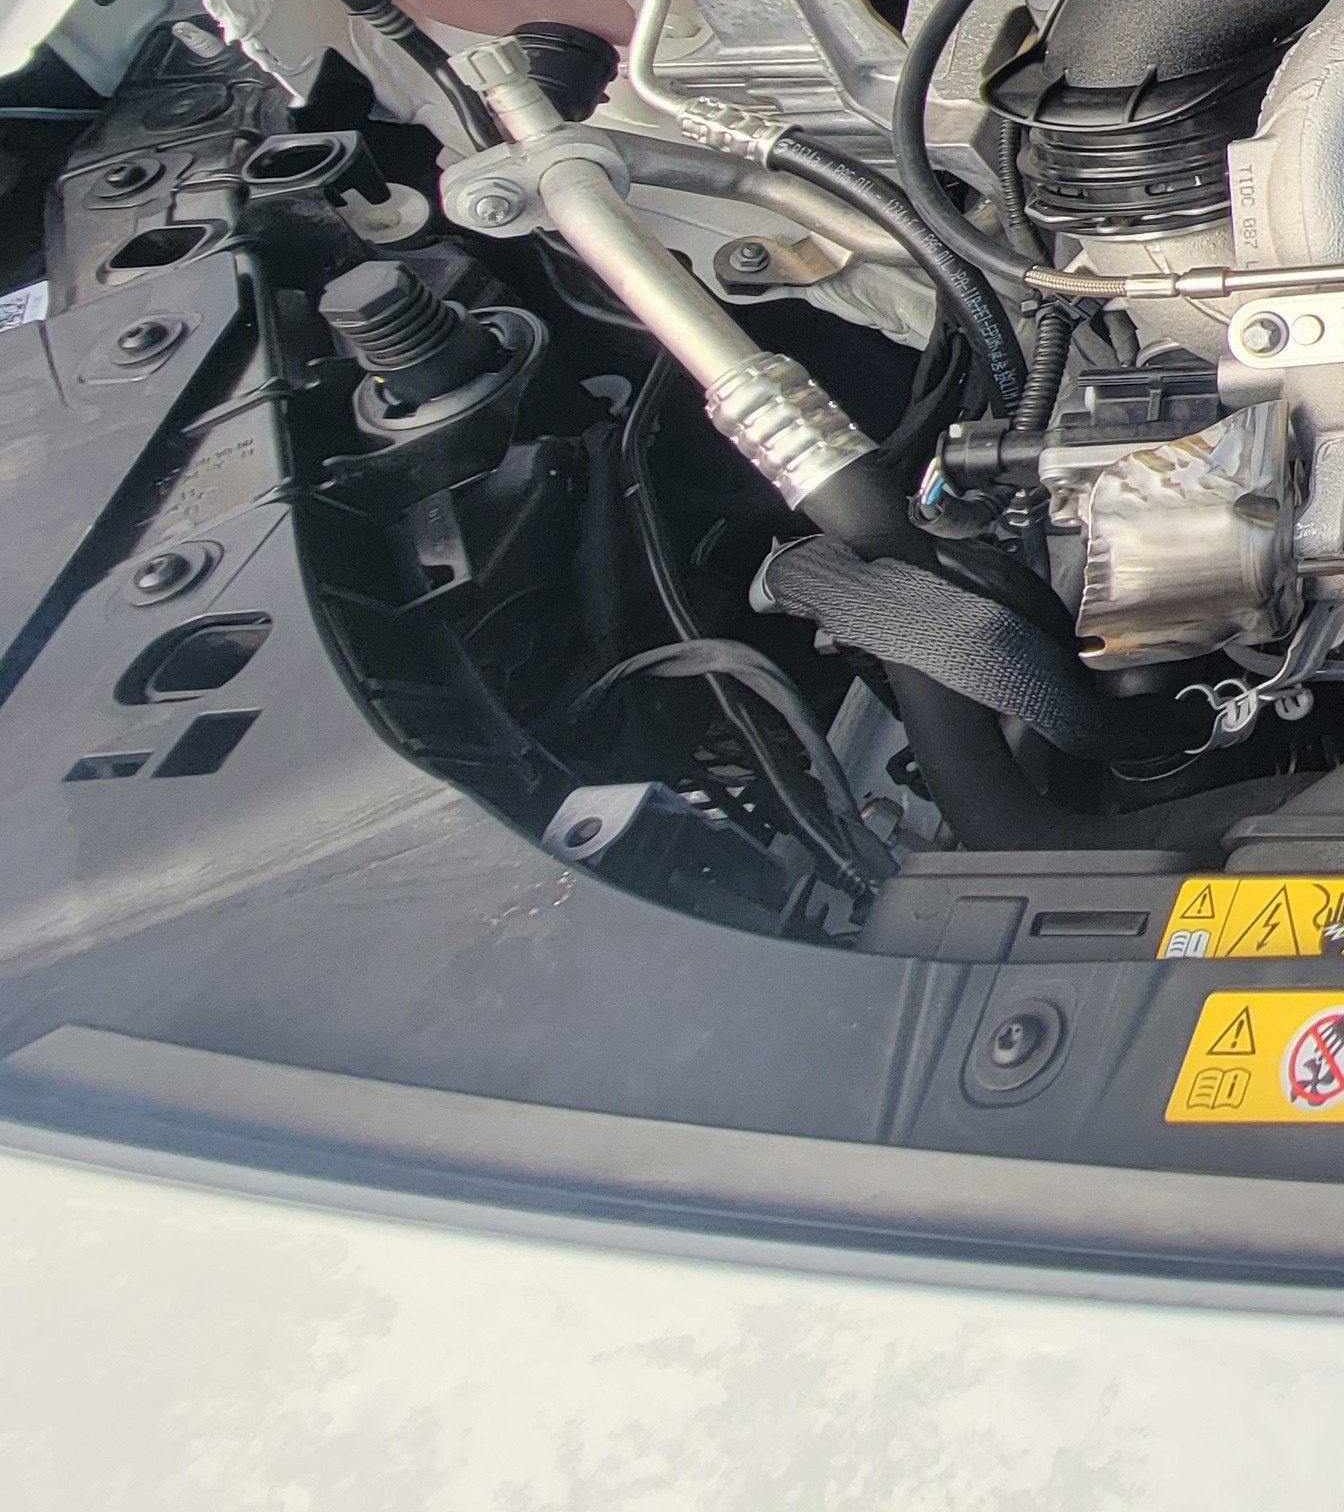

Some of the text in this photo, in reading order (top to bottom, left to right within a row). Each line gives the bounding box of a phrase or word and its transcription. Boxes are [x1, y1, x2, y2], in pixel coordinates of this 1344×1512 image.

[832, 163, 856, 185] PAG
[852, 177, 875, 198] OIL
[920, 233, 942, 254] PAG
[935, 249, 956, 271] OIL
